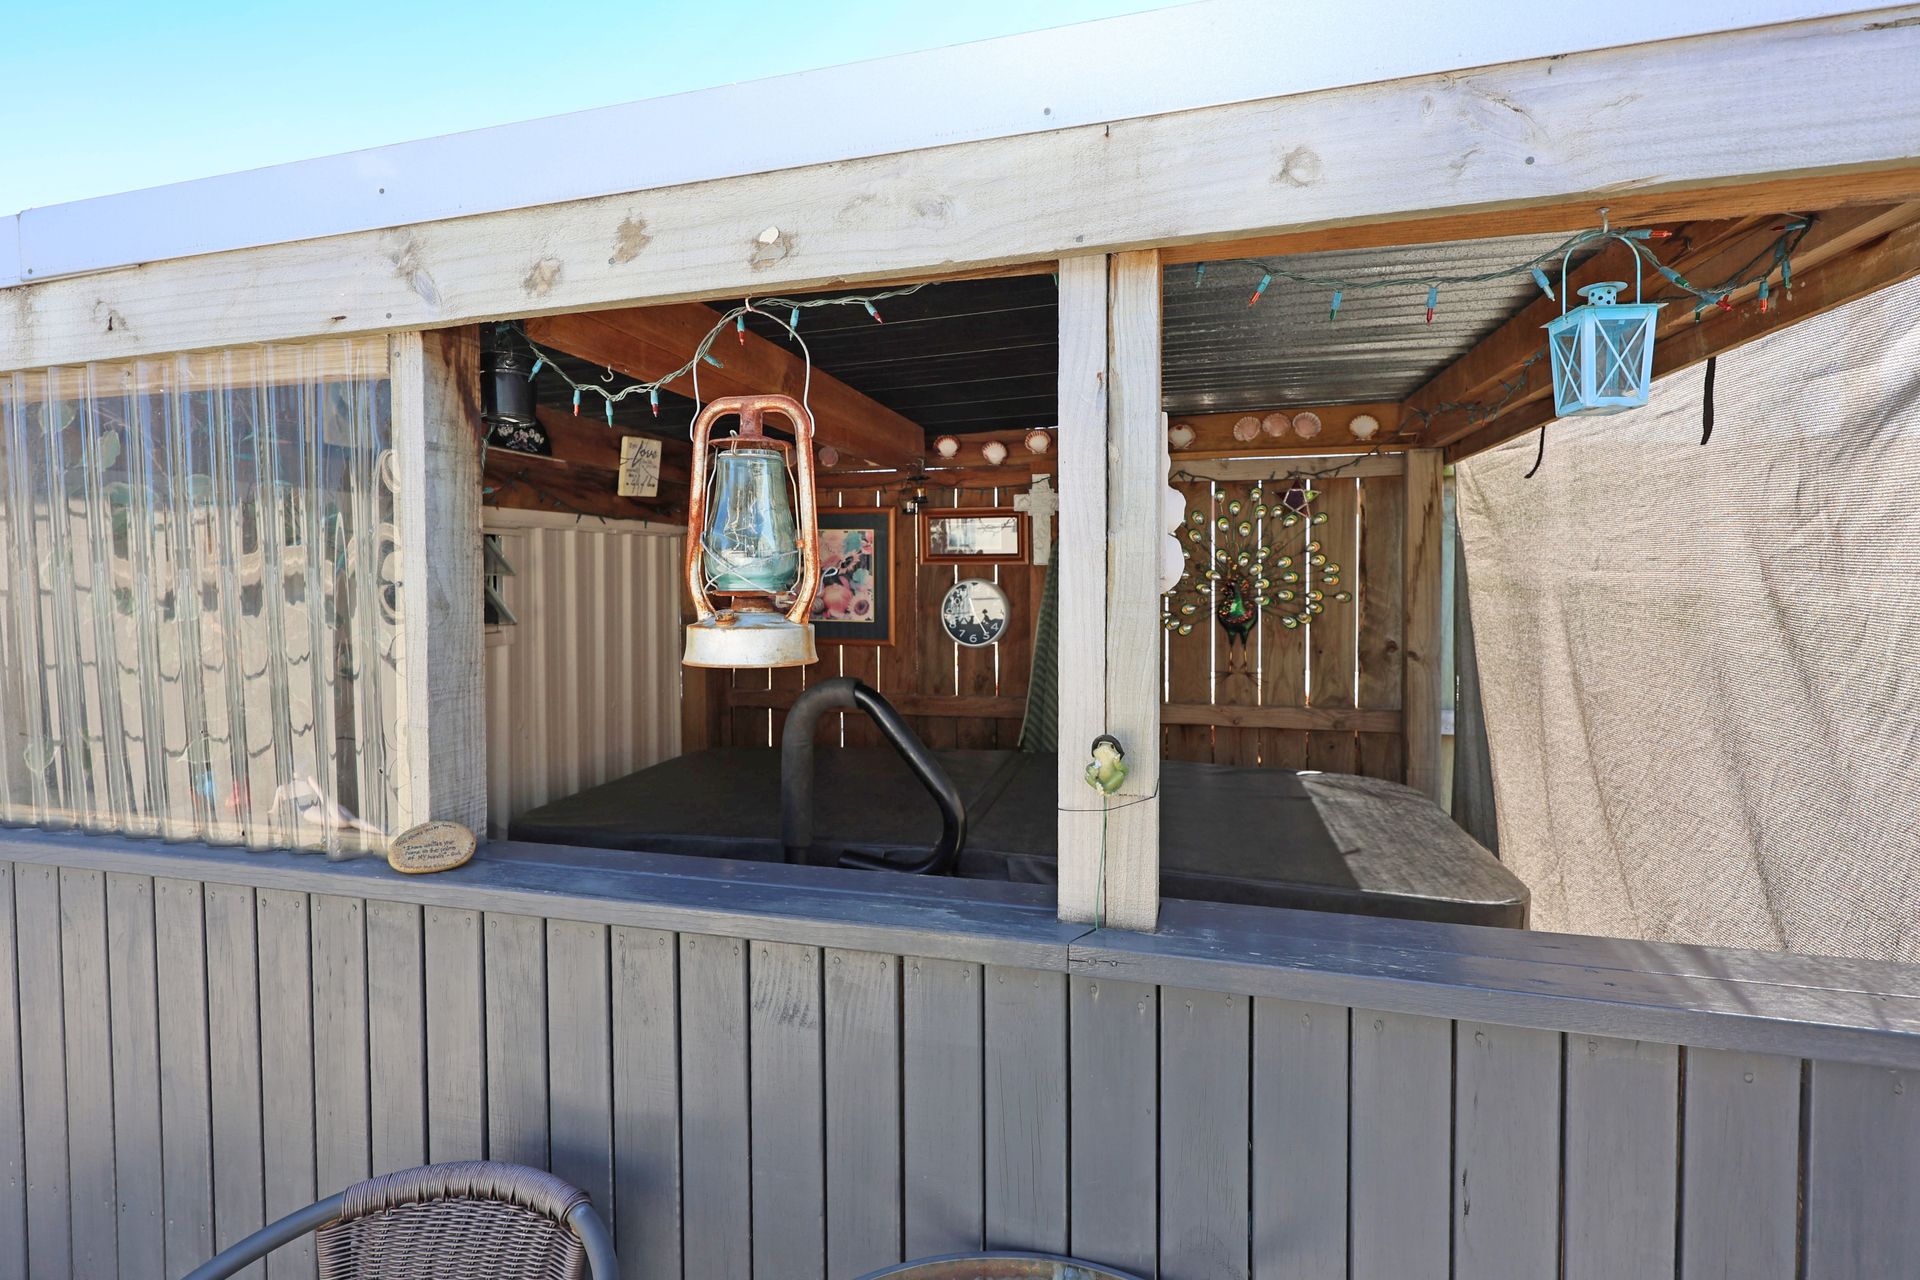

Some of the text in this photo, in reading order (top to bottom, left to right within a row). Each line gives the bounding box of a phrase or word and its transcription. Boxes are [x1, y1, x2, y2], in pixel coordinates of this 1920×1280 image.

[991, 623, 999, 631] 4
[959, 629, 965, 637] 7
[983, 632, 990, 640] 5
[969, 634, 977, 643] 6
